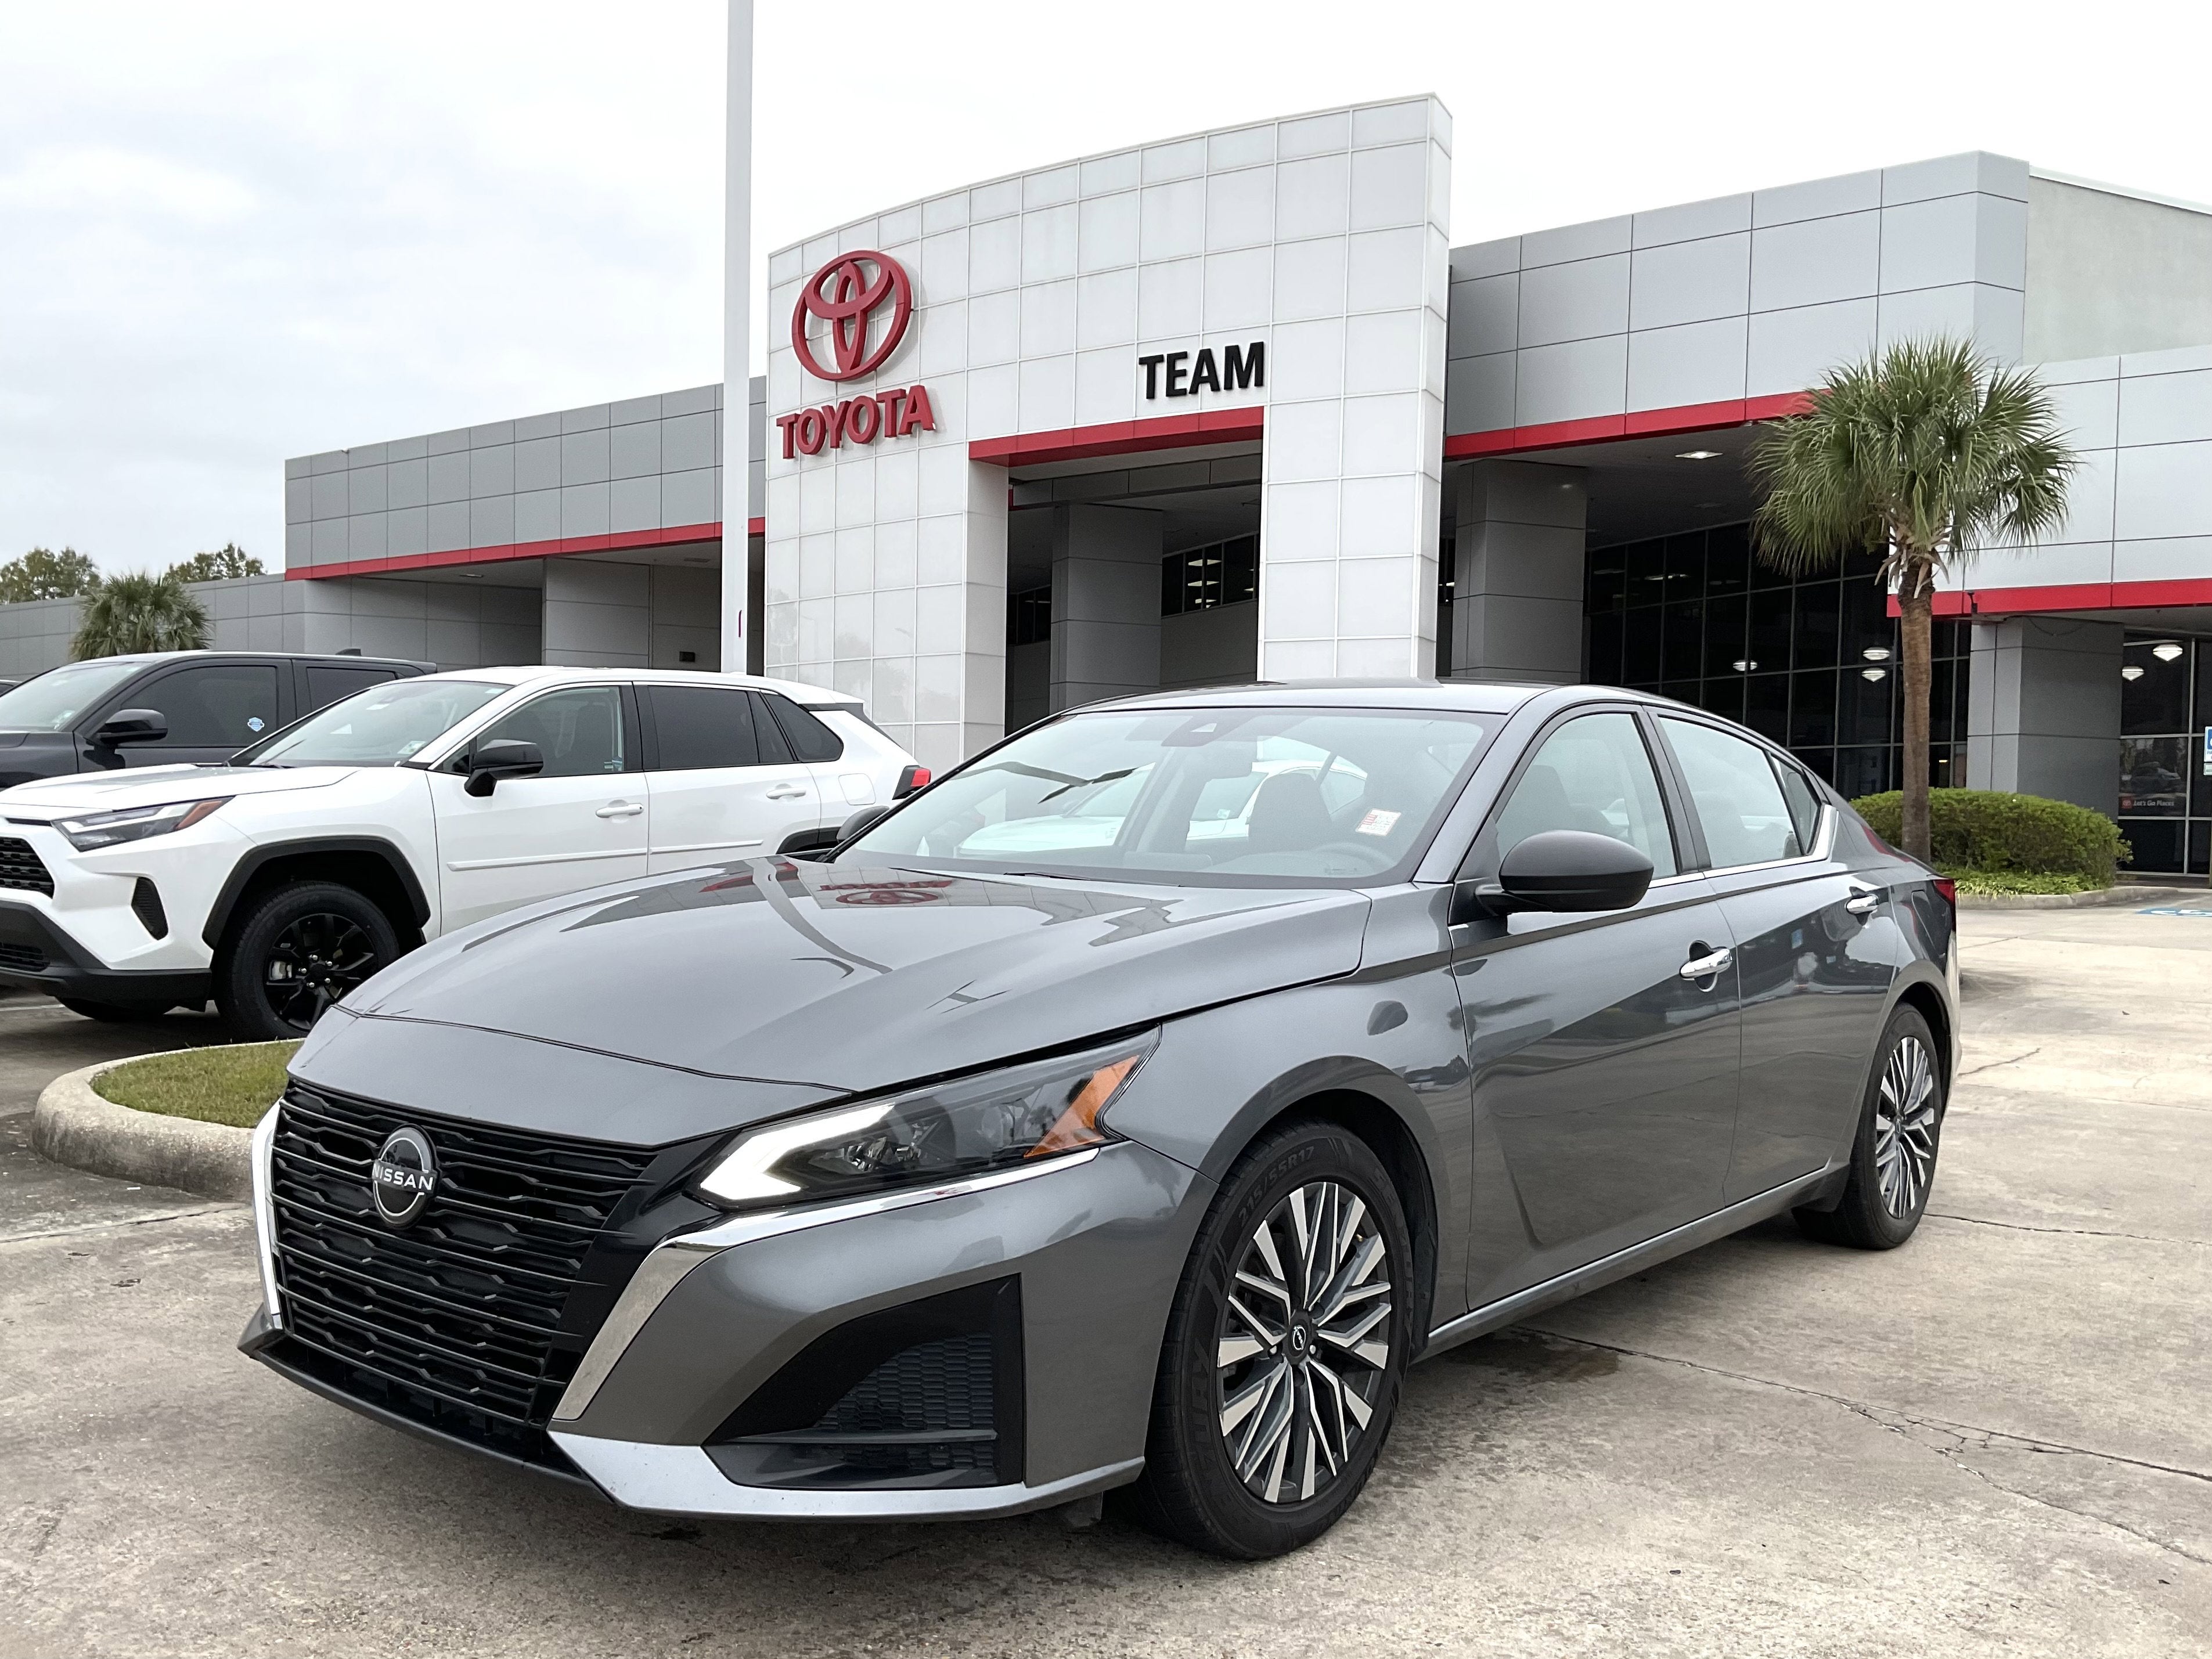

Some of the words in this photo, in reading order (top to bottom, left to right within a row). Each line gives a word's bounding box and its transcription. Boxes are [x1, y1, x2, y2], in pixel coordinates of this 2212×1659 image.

[1139, 341, 1264, 399] TEAM
[776, 384, 936, 459] TOYOTA
[372, 1163, 434, 1191] NISSAN
